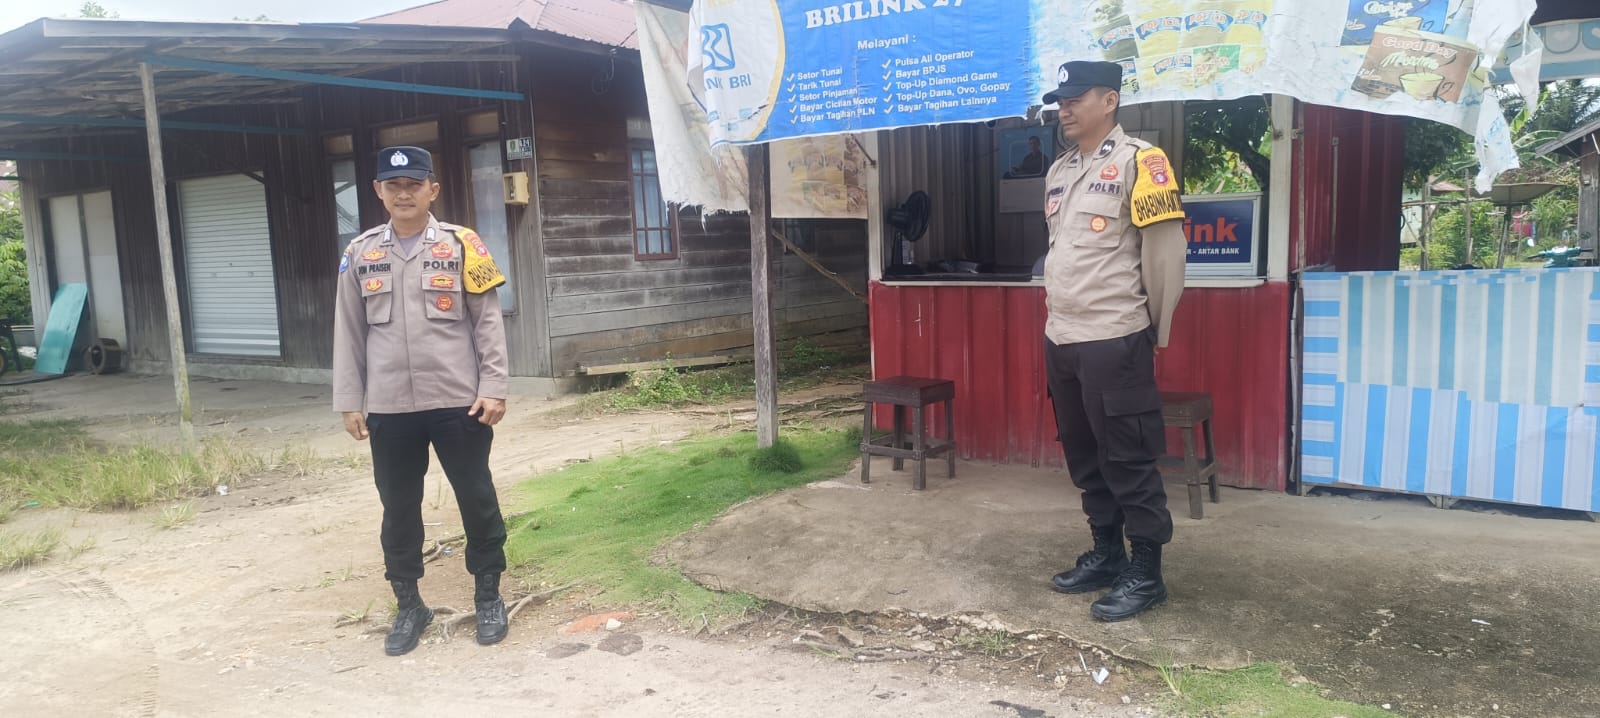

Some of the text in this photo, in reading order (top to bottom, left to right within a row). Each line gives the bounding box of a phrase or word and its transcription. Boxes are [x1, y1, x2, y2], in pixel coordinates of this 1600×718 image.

[805, 0, 926, 29] BRILINK
[857, 34, 909, 51] Melayani
[1382, 36, 1458, 59] Good Day
[895, 50, 975, 67] Pulsa All Operator
[729, 73, 752, 89] BRI
[797, 67, 843, 81] Setor Tunai
[895, 65, 947, 80] Bayar BPJS
[896, 71, 998, 91] Top-Up Diamond Game
[798, 78, 841, 91] Tarik Tunai
[896, 82, 1011, 102] Top-Up Dana, Ovo, Gopay
[799, 88, 858, 102] Setor Pinjaman
[800, 102, 823, 113] Bayar
[853, 96, 878, 107] Motor
[897, 95, 997, 113] Bayar Tagihan Lainnya
[800, 107, 876, 124] Bayar Tagihan PLN
[1087, 182, 1121, 195] POLRI
[1183, 216, 1238, 243] ink
[1198, 247, 1220, 255] ANTAR
[1221, 247, 1240, 255] BANK
[423, 260, 459, 272] POLRI
